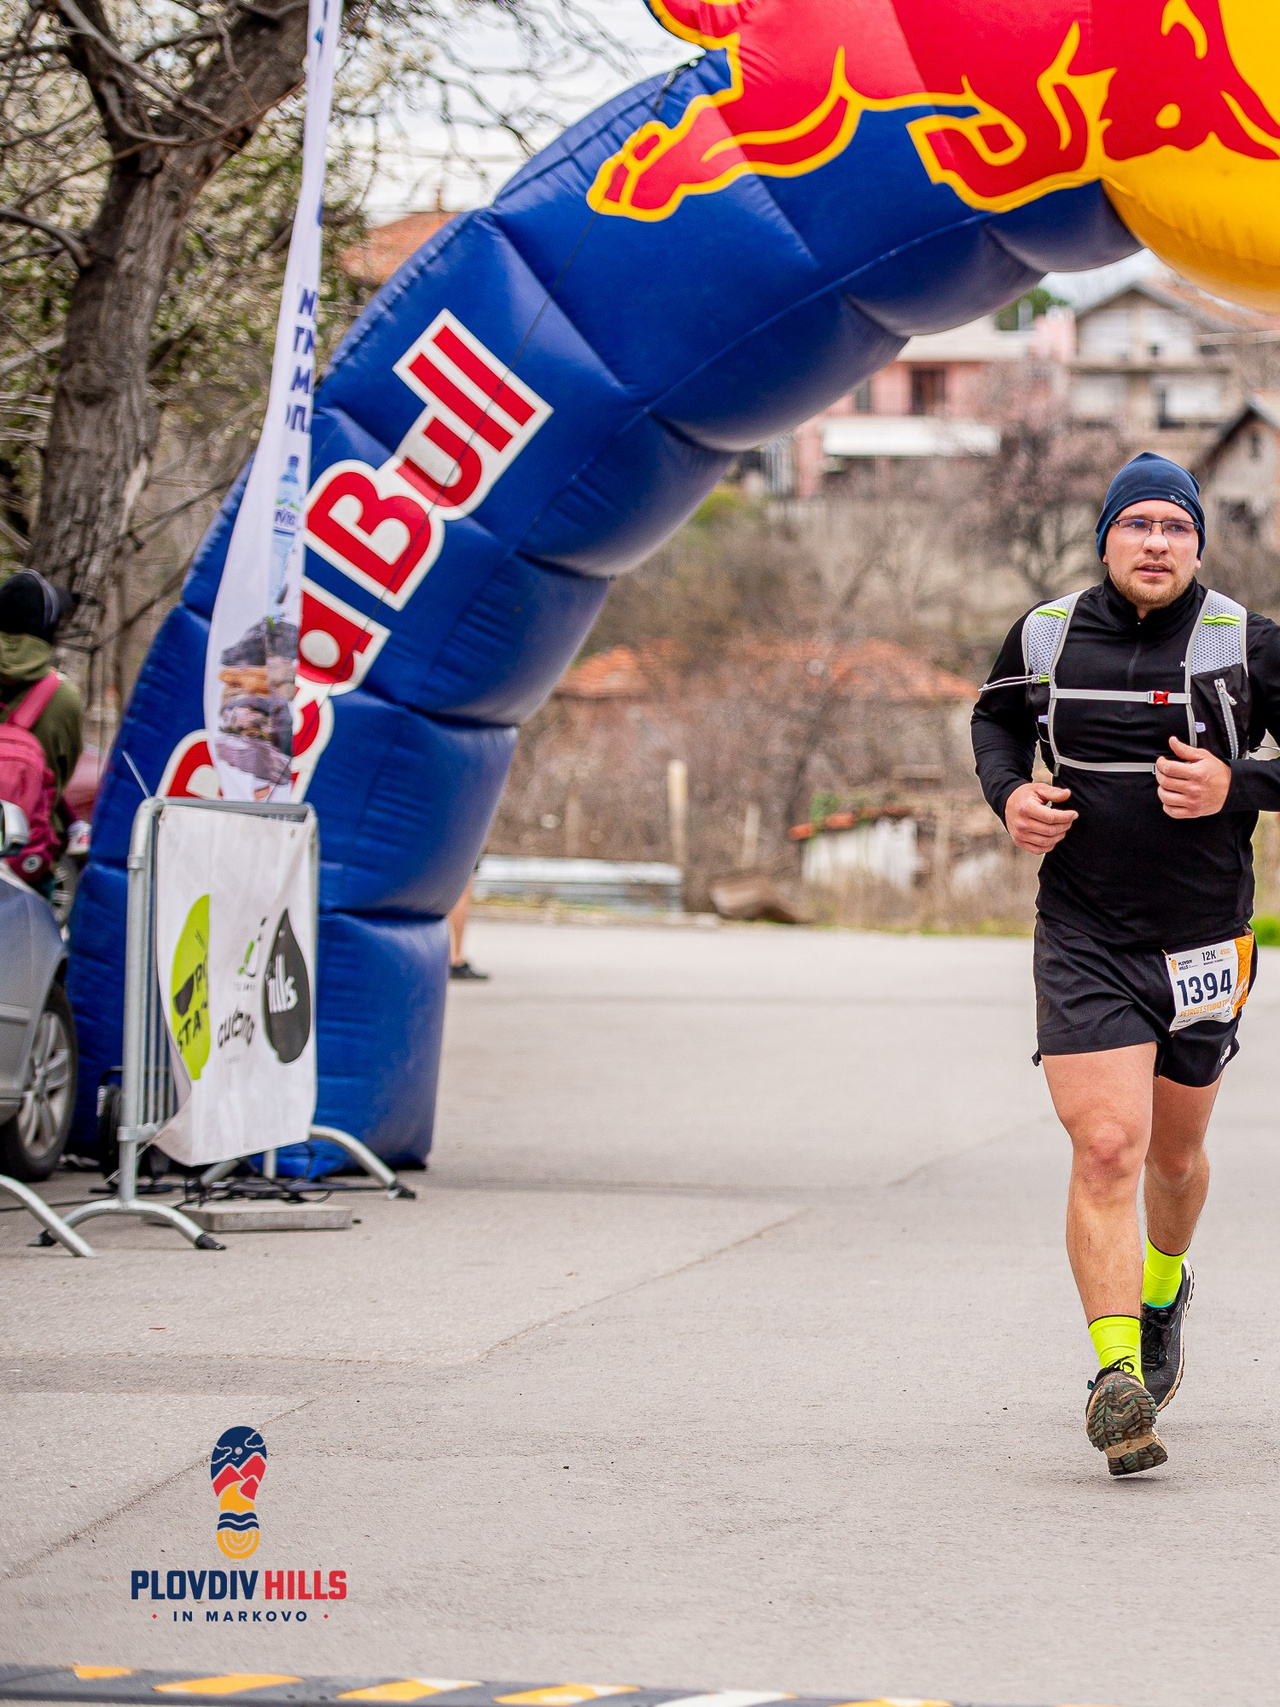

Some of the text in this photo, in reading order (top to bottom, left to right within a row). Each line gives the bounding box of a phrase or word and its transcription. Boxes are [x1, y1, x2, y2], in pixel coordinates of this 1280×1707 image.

[307, 324, 537, 597] Bull
[1202, 950, 1217, 961] 12K
[1176, 969, 1233, 1006] 1394
